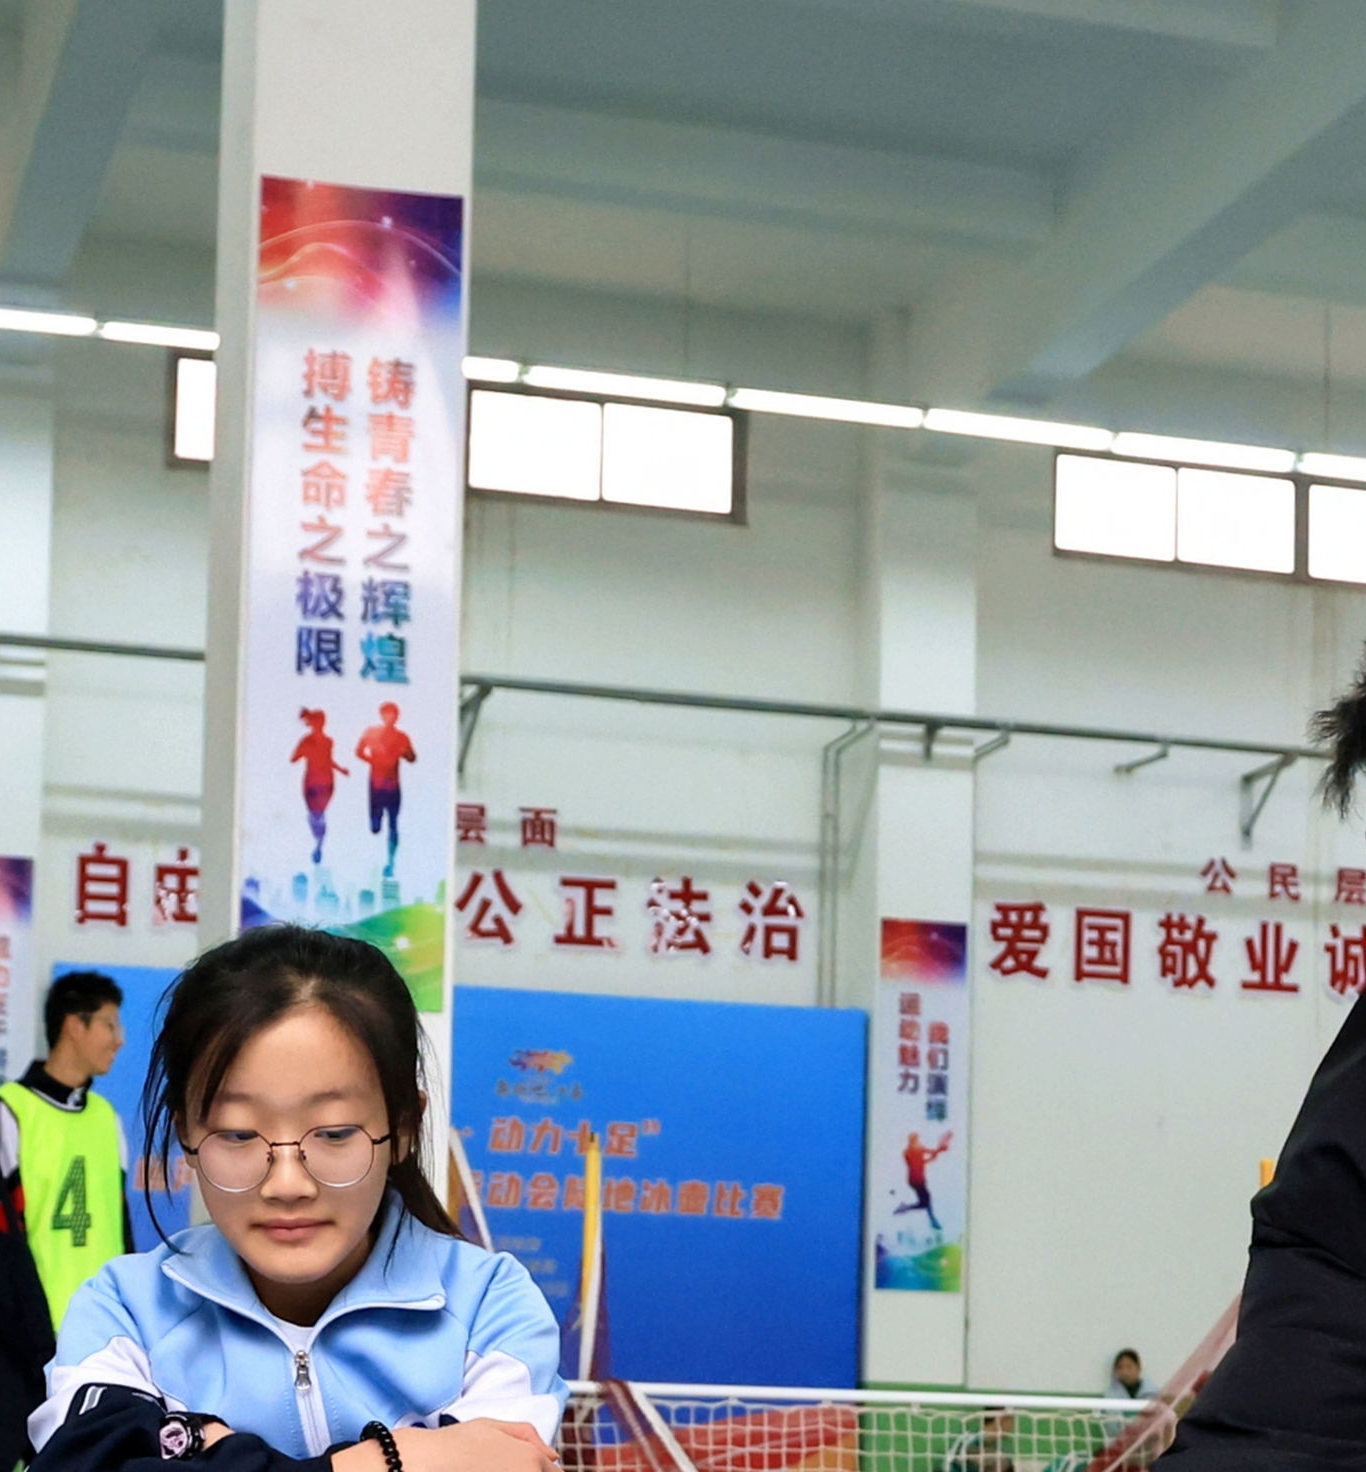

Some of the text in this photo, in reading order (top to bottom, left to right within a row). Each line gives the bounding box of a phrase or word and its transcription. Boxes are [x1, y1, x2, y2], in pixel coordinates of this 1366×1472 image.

[295, 348, 351, 678] 搏生命之极限
[359, 356, 415, 685] 铸青春之辉煌
[51, 1154, 93, 1248] 4
